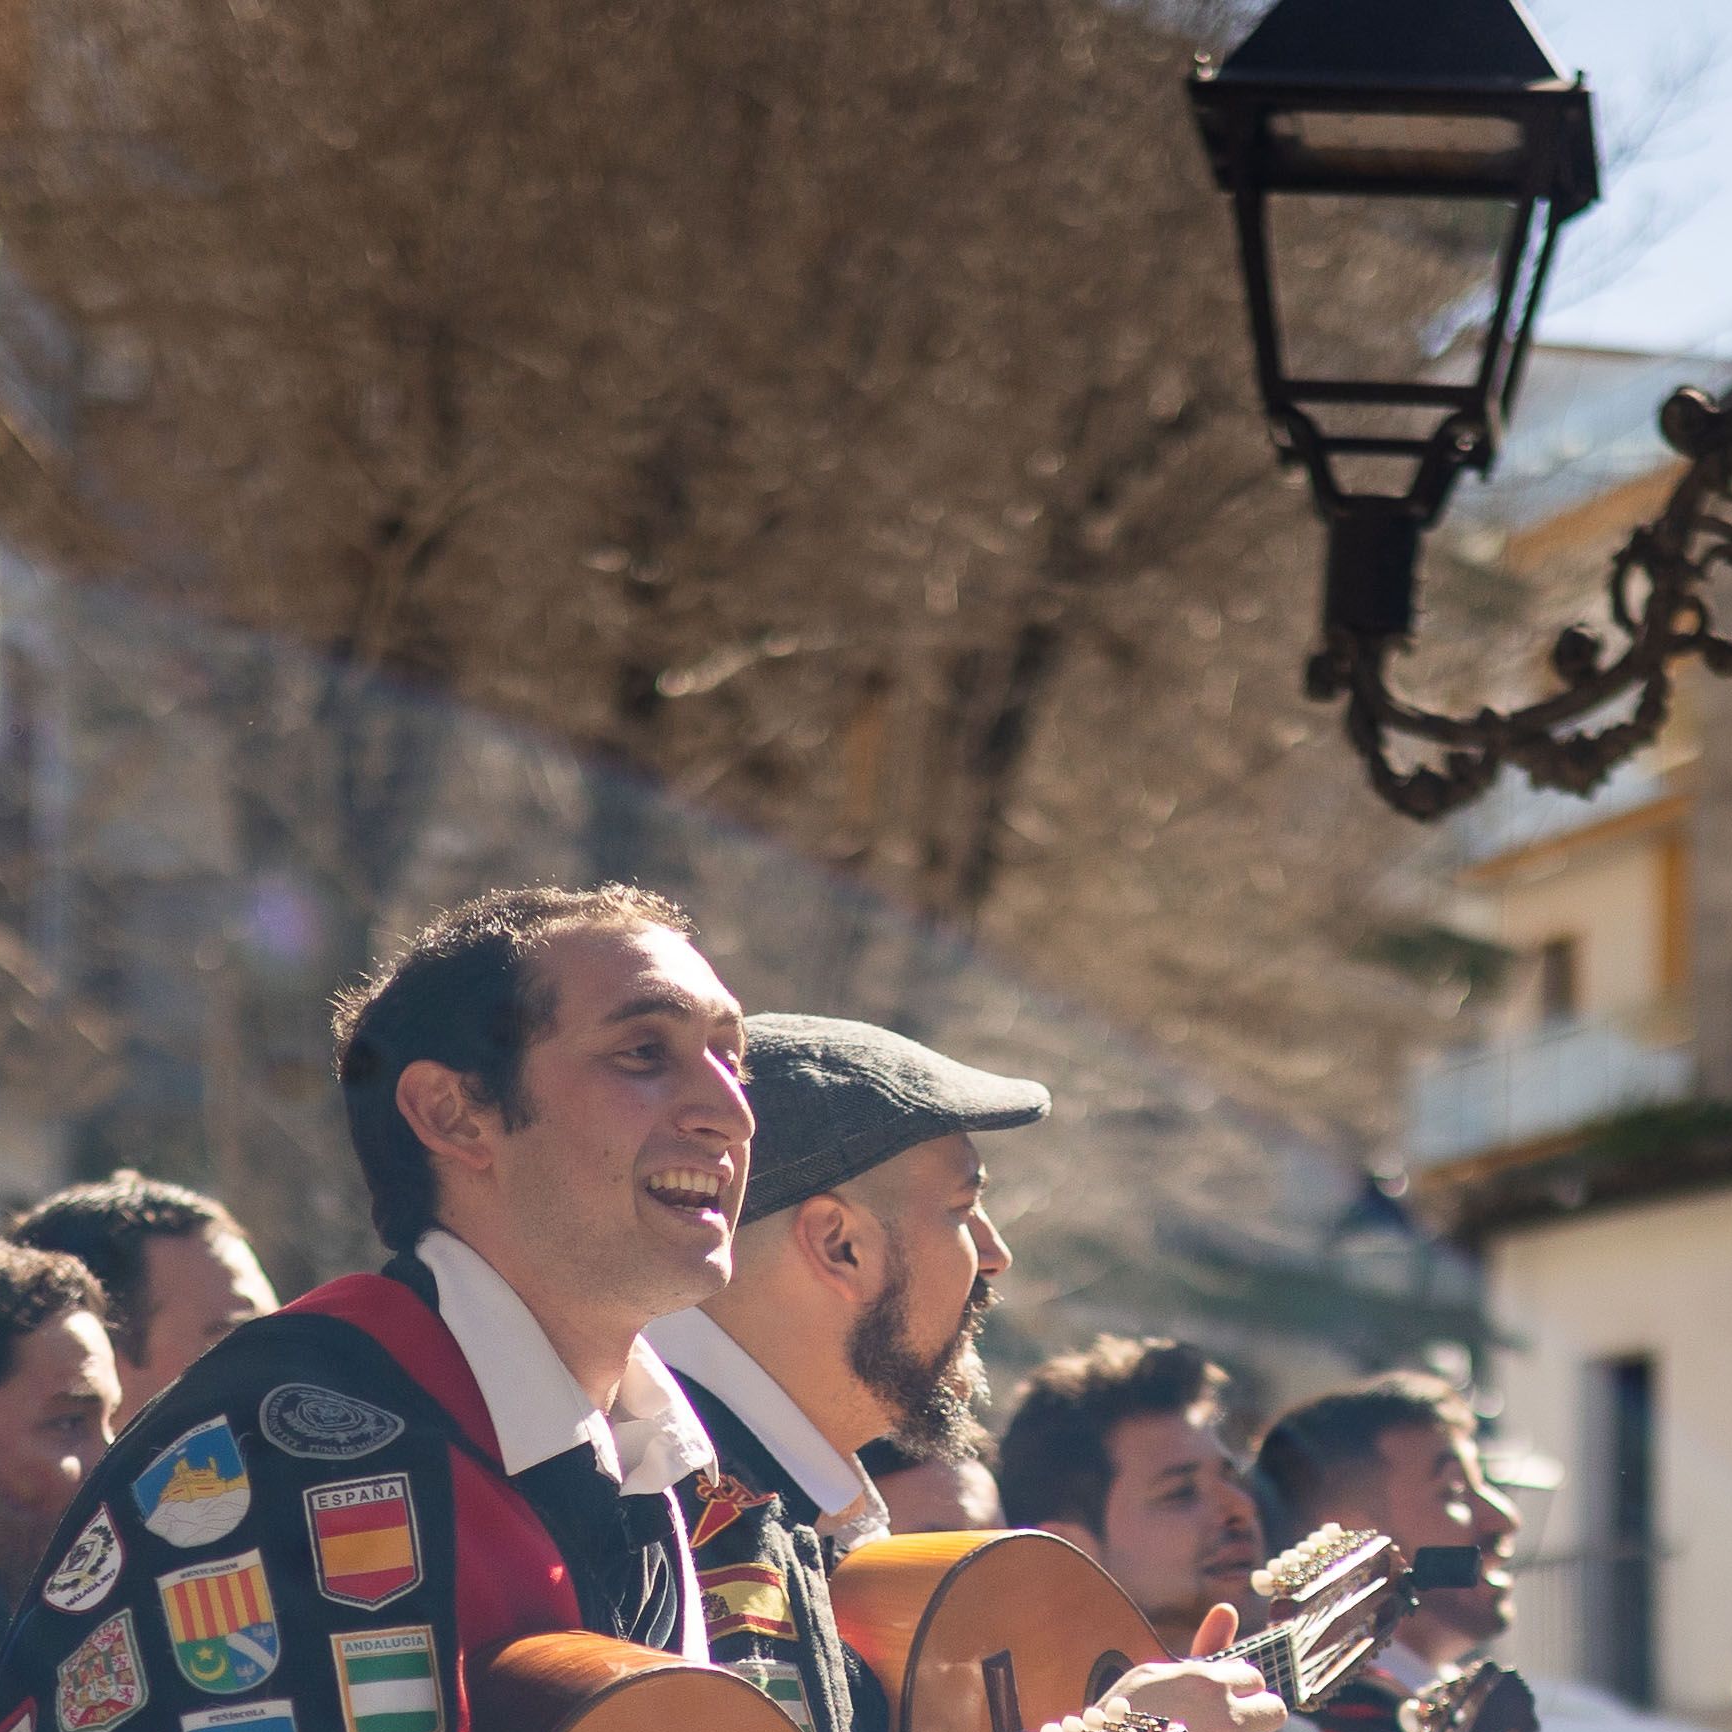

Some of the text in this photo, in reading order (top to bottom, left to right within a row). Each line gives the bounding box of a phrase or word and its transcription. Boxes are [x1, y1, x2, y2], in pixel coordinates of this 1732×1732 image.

[317, 1483, 399, 1509] ESPAÑA
[343, 1635, 426, 1653] ANDALUCIA
[207, 1707, 268, 1725] PEÑISCOLA
